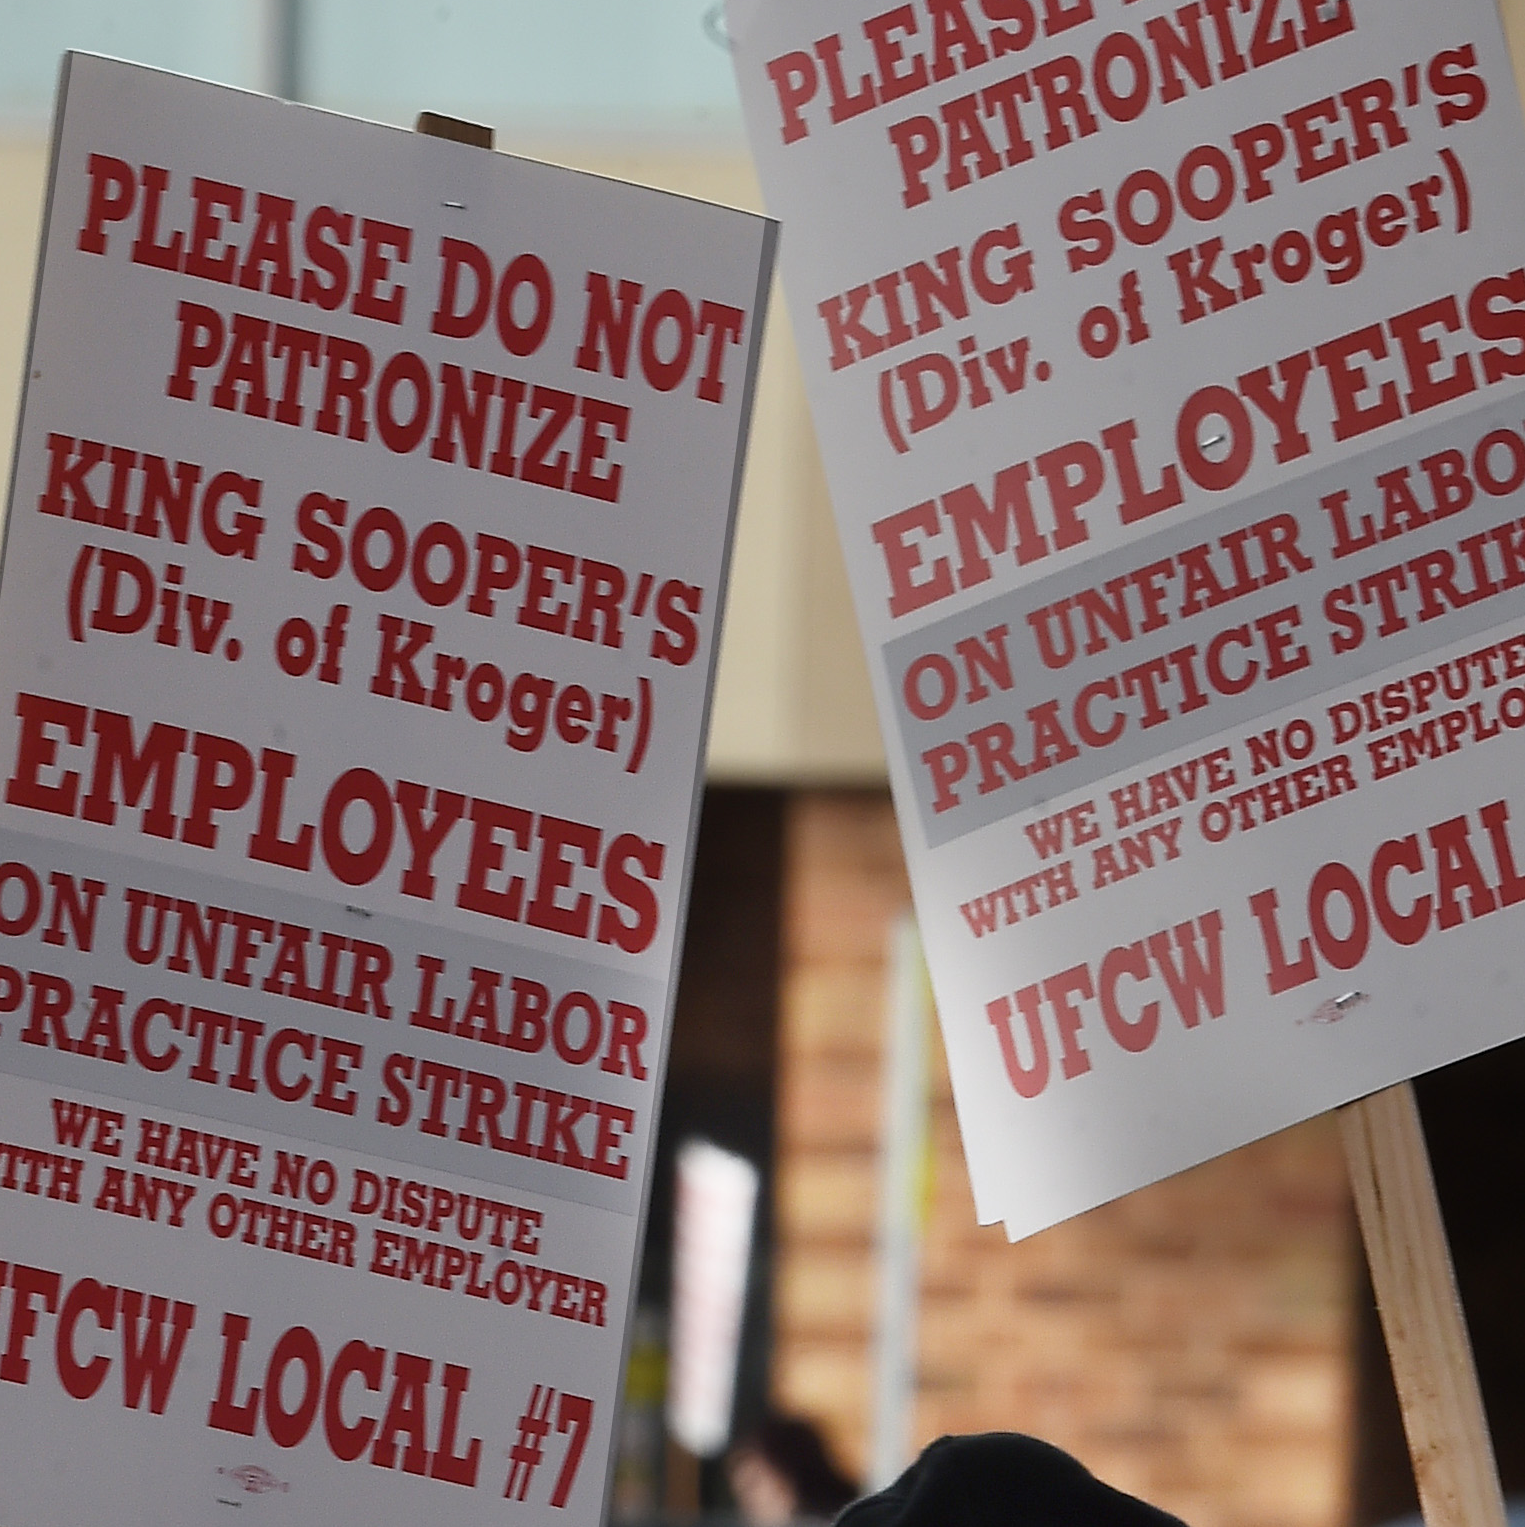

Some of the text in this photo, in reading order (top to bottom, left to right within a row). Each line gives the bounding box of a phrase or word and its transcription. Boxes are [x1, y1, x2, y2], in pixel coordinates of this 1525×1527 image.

[77, 153, 745, 404] PLEASE DO NOT
[819, 44, 1488, 371] KING SOOPER'S
[880, 149, 1471, 453] (Div. of Kroger)
[167, 301, 631, 503] PATRONIZE
[872, 269, 1525, 617] EMPLOYEES
[38, 433, 703, 666] KING SOOPER'S
[68, 545, 653, 774] (Div. of Kroger)
[904, 430, 1525, 721] ON UNFAIR LABO
[5, 693, 665, 954] EMPLOYEES
[922, 606, 1311, 813] PRACTICE
[960, 688, 1525, 937] WITH ANY OTHER EMPLO
[1025, 635, 1525, 859] WE HAVE NO DISPUTE
[125, 889, 393, 1019] UNFAIR
[410, 956, 648, 1081] LABOR
[986, 801, 1525, 1099] UFCW LOCAL
[52, 1100, 542, 1255] WE HAVE NO DISPUTE
[378, 1054, 634, 1180] STRIKE
[95, 1167, 196, 1227] ANY
[208, 1193, 357, 1267] OTHER
[370, 1230, 607, 1327] EMPLOYER
[208, 1313, 482, 1487] LOCAL
[505, 1385, 594, 1508] #7
